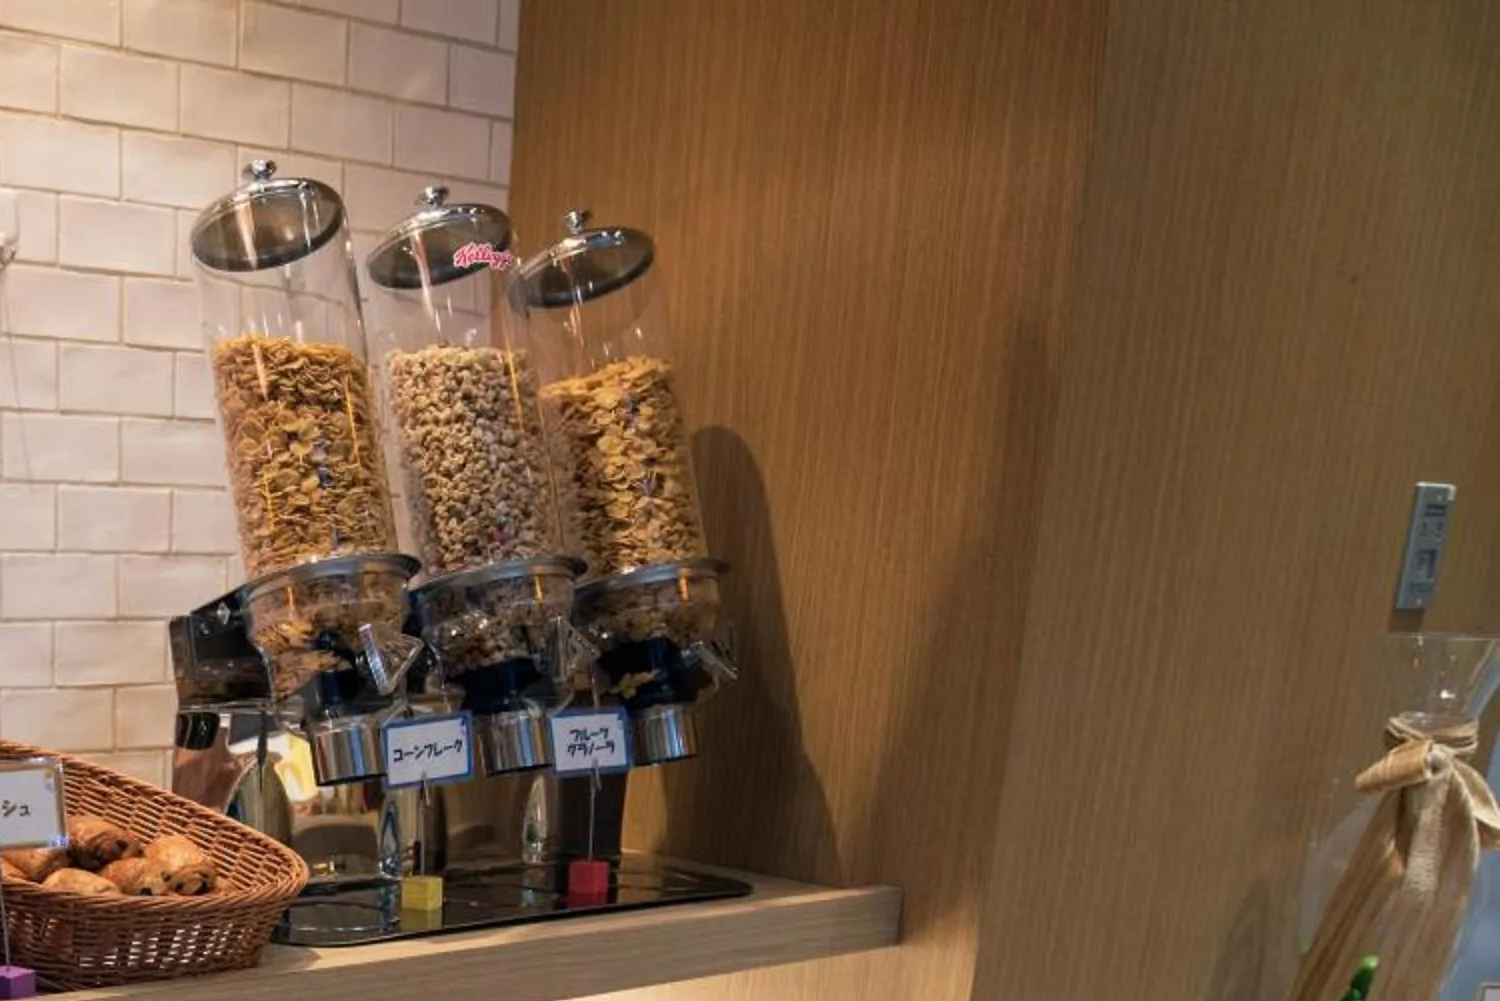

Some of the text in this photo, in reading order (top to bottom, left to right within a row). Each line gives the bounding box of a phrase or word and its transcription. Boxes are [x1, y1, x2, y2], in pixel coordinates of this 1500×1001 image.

[393, 739, 463, 762] コーンフレーク
